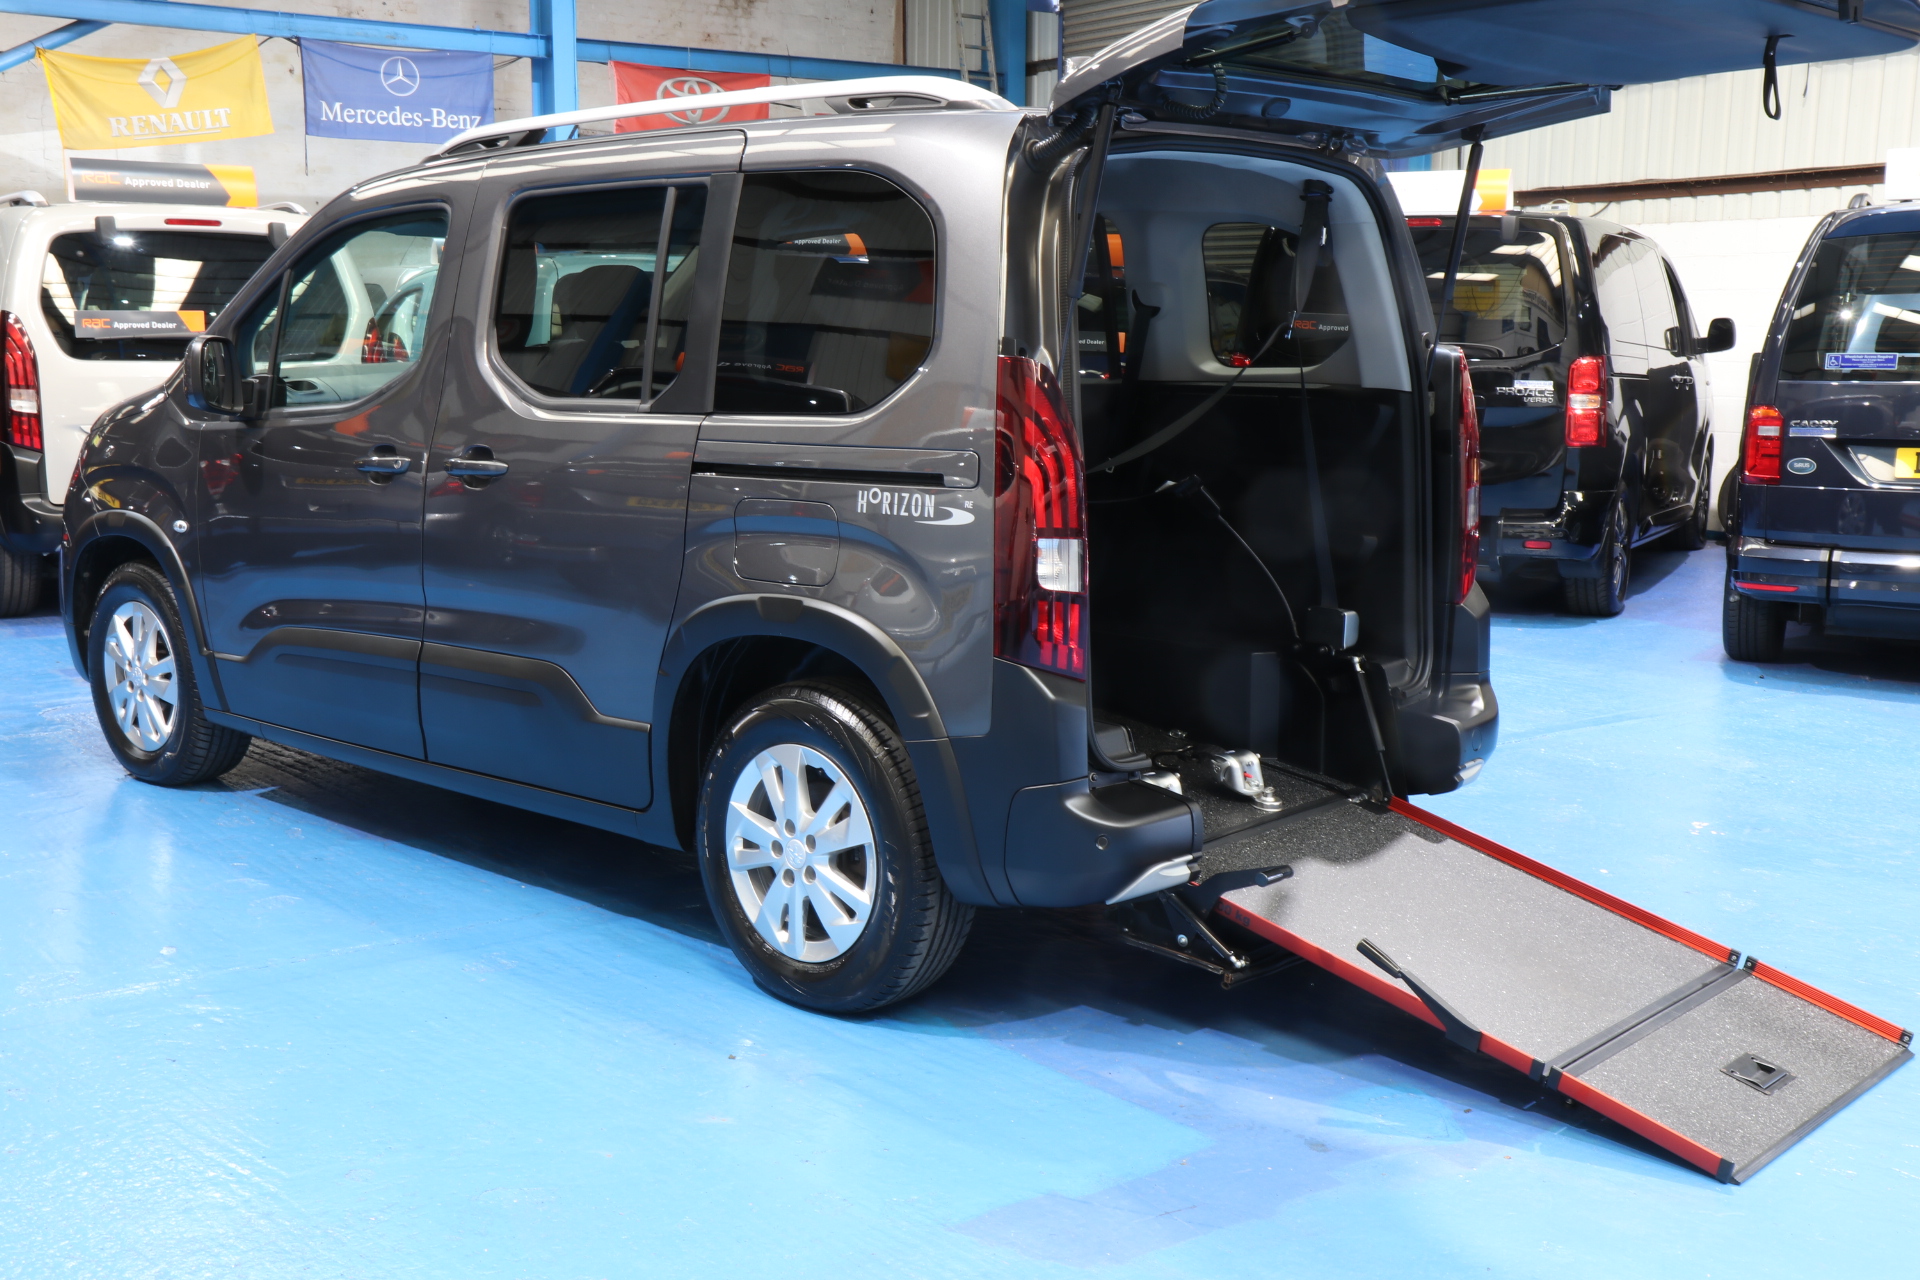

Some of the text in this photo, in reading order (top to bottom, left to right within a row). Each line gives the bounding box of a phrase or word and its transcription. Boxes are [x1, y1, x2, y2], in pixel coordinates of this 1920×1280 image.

[320, 100, 481, 129] Mercedes-Benz
[107, 108, 231, 137] RENAULT
[125, 176, 174, 188] Approved
[177, 178, 210, 189] Dealer
[113, 321, 150, 330] Approved
[152, 321, 177, 329] Dealer
[1318, 323, 1349, 331] Approved
[1495, 386, 1555, 397] PROACE
[1523, 396, 1554, 404] VERSO
[857, 487, 935, 518] HORIZON
[964, 500, 974, 509] RE
